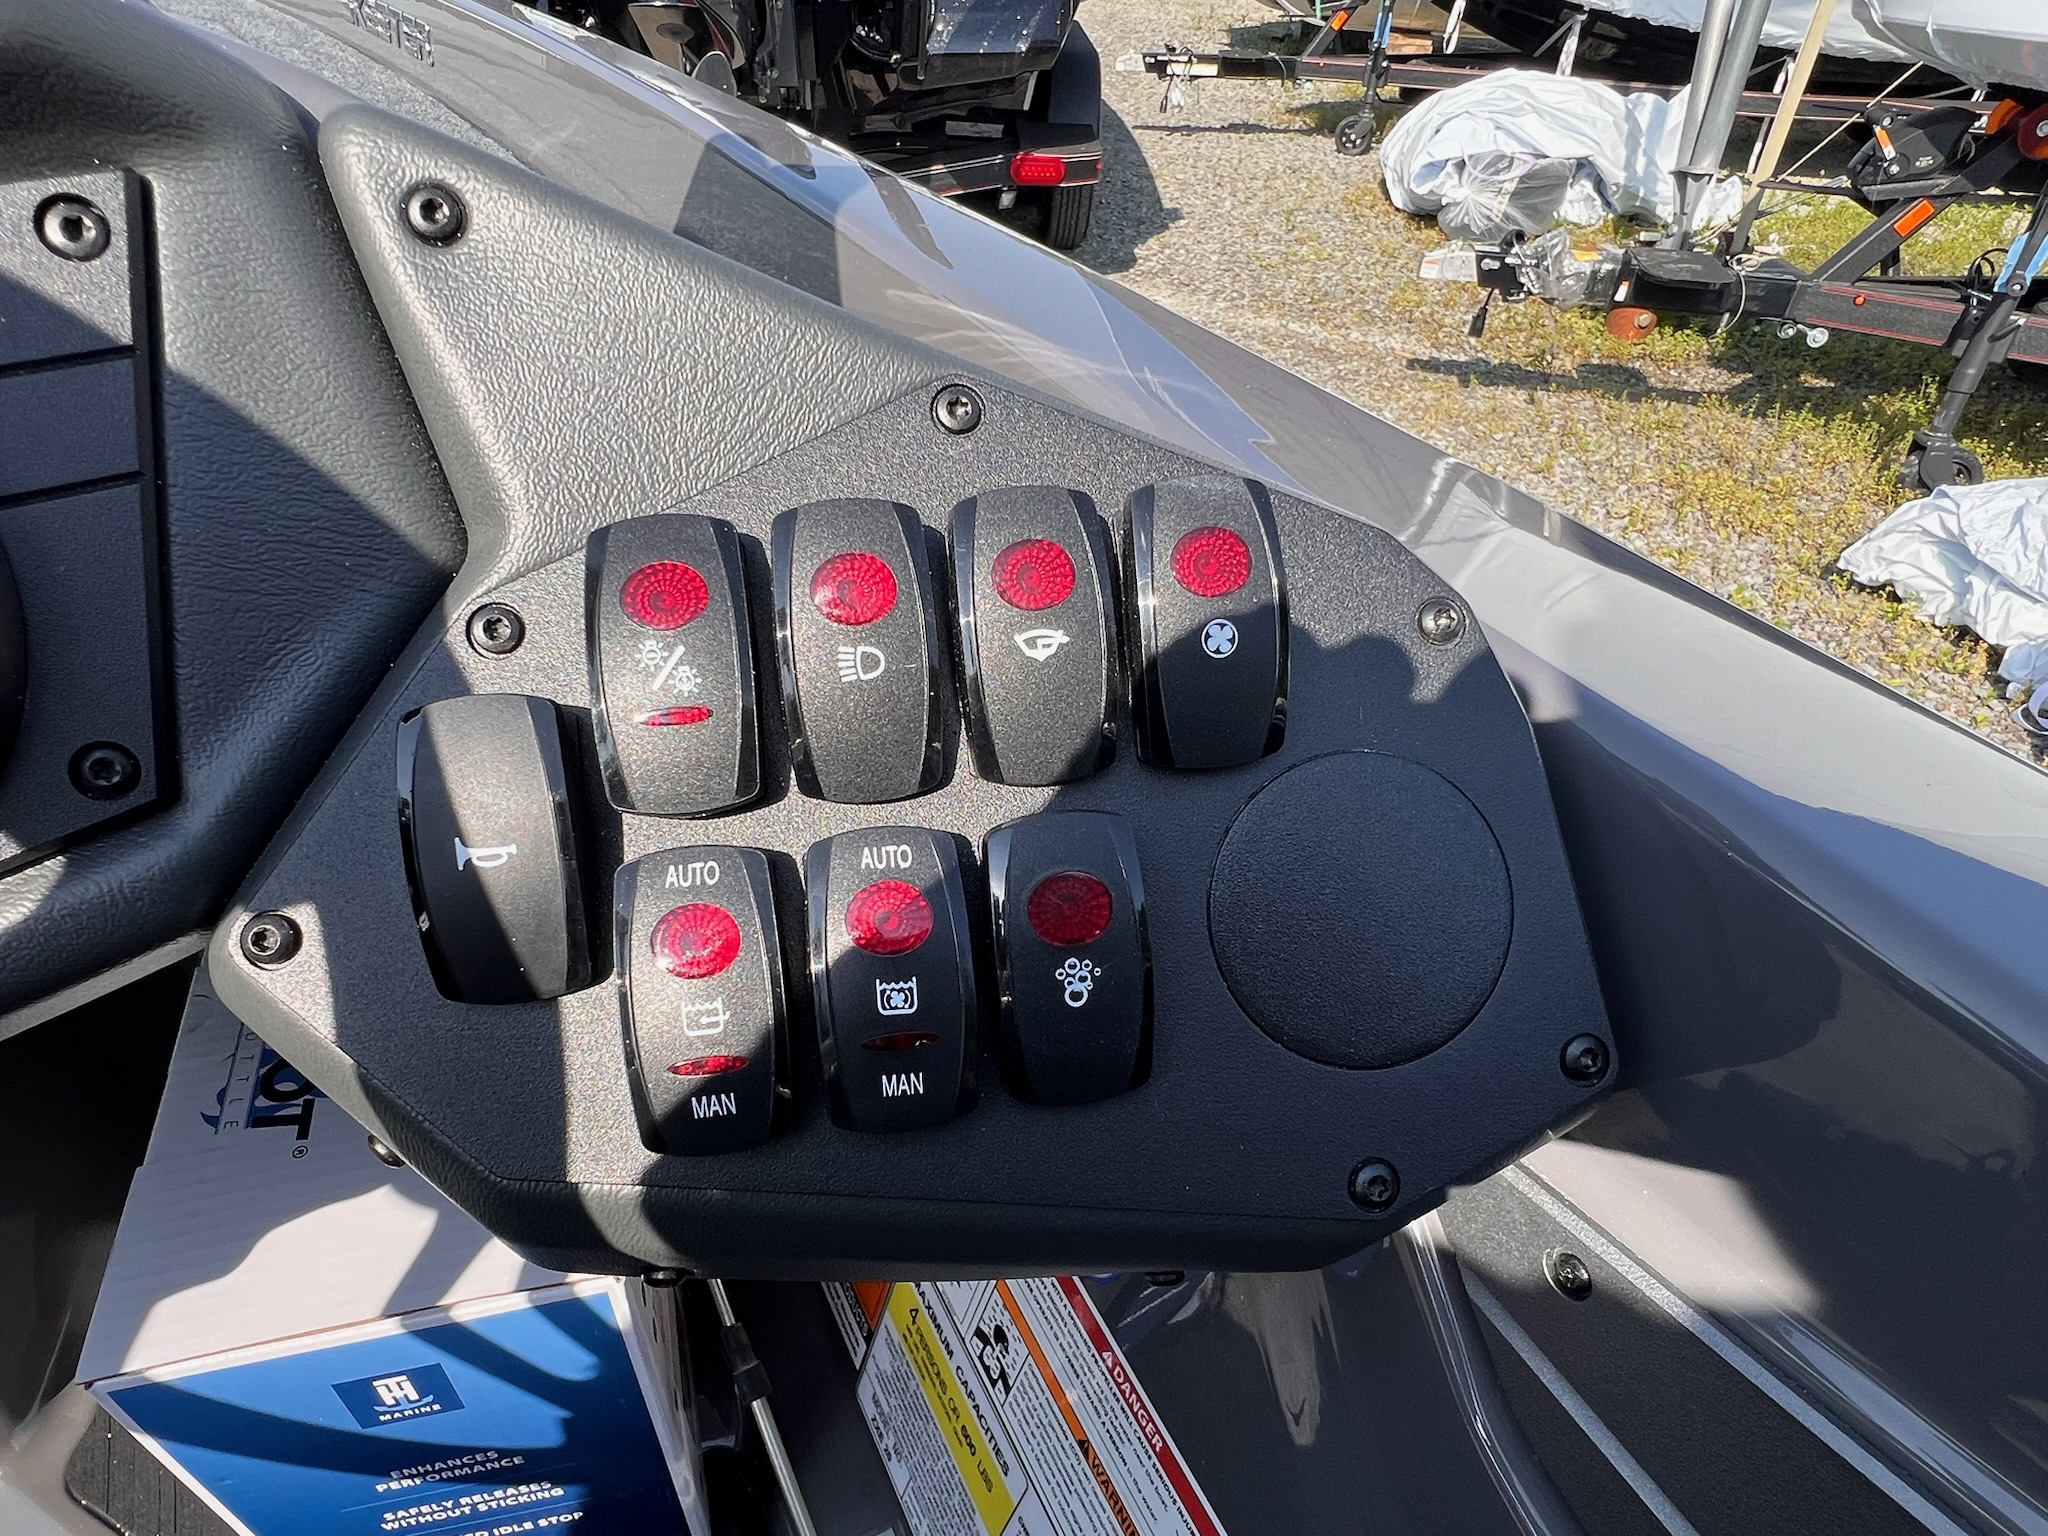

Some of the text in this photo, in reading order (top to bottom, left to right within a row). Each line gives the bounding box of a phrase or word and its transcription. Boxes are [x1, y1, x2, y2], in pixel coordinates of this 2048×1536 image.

[665, 861, 720, 889] AUTO
[861, 844, 912, 869] AUTO
[880, 1072, 924, 1098] MAN
[690, 1093, 737, 1119] MAN
[379, 1403, 442, 1422] MARINE
[909, 1305, 920, 1326] 4
[915, 1324, 947, 1395] PERSONS
[947, 1396, 961, 1424] OR
[976, 1459, 993, 1493] LBS
[1113, 1365, 1162, 1453] DANGER
[956, 1364, 1008, 1477] CAPACITIES
[1091, 1352, 1119, 1404] PROPELLER
[1119, 1404, 1133, 1428] WILL
[1133, 1428, 1151, 1461] CAUSE
[1152, 1462, 1176, 1506] SERIOUS
[1106, 1428, 1126, 1466] PERSON
[1132, 1477, 1141, 1494] the
[1109, 1404, 1118, 1420] the
[1118, 1420, 1132, 1446] water
[1133, 1447, 1144, 1467] near
[1145, 1469, 1154, 1485] the
[375, 1456, 525, 1493] PERFORMANCE
[390, 1451, 499, 1480] ENHANCES
[380, 1487, 565, 1531] WITHOUT STICKING
[382, 1481, 552, 1521] SAFELY RELEASES
[493, 1511, 584, 1536] IDLE STOP
